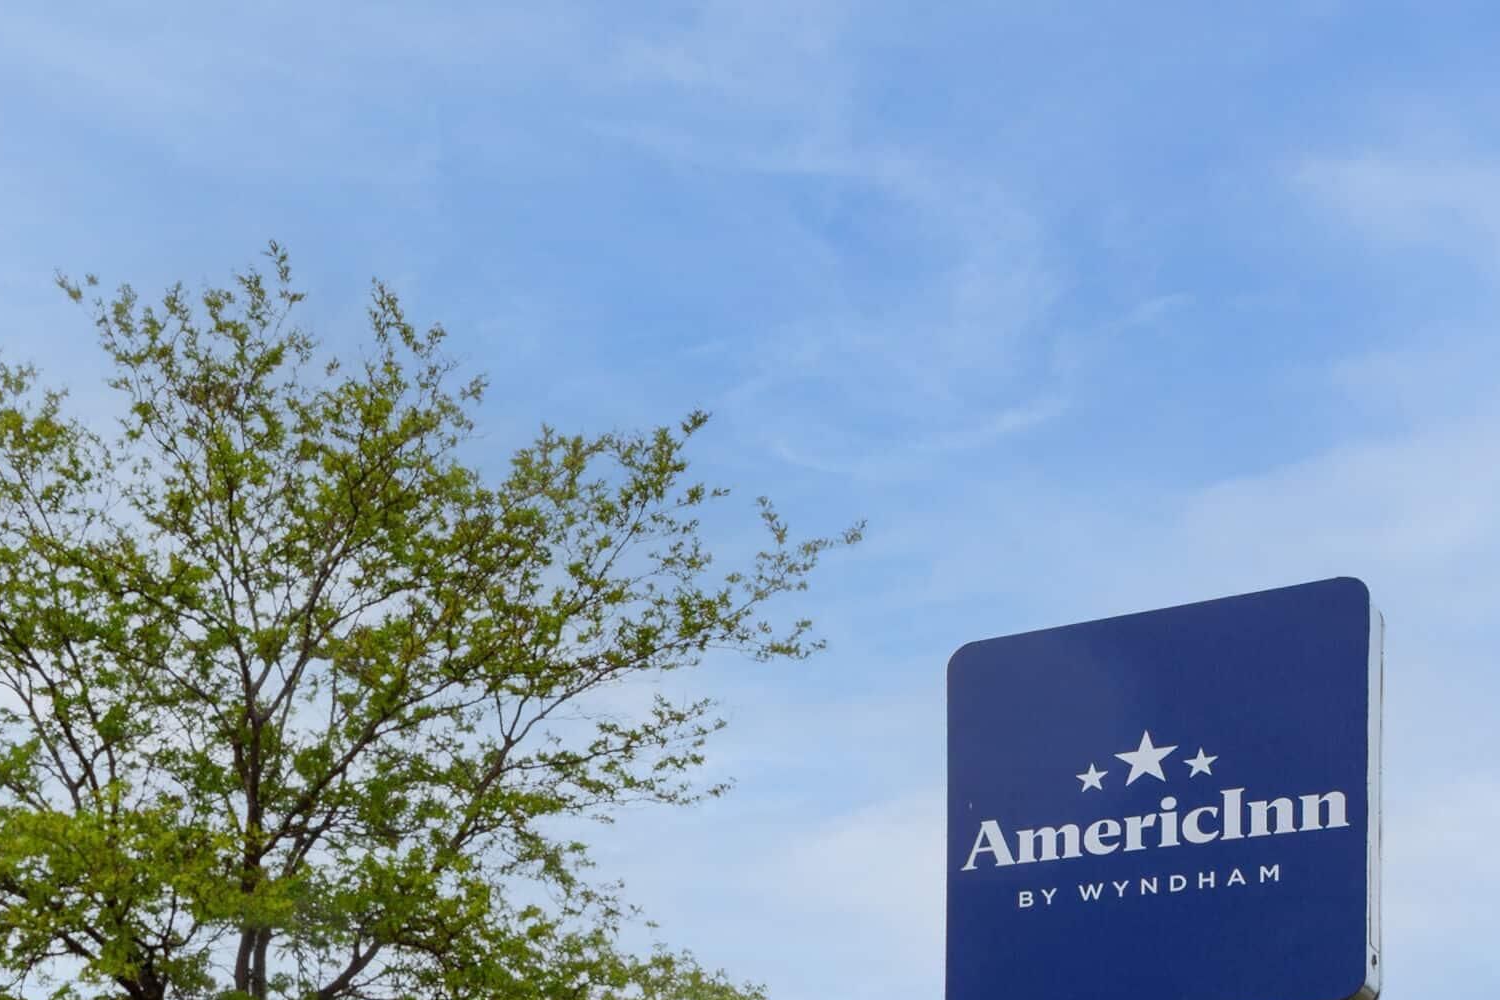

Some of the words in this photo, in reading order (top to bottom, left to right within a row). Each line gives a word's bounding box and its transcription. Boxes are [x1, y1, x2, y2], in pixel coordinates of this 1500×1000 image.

[961, 787, 1350, 871] AmericInn
[1018, 887, 1057, 908] BY
[1079, 864, 1281, 902] WYNDHAM
